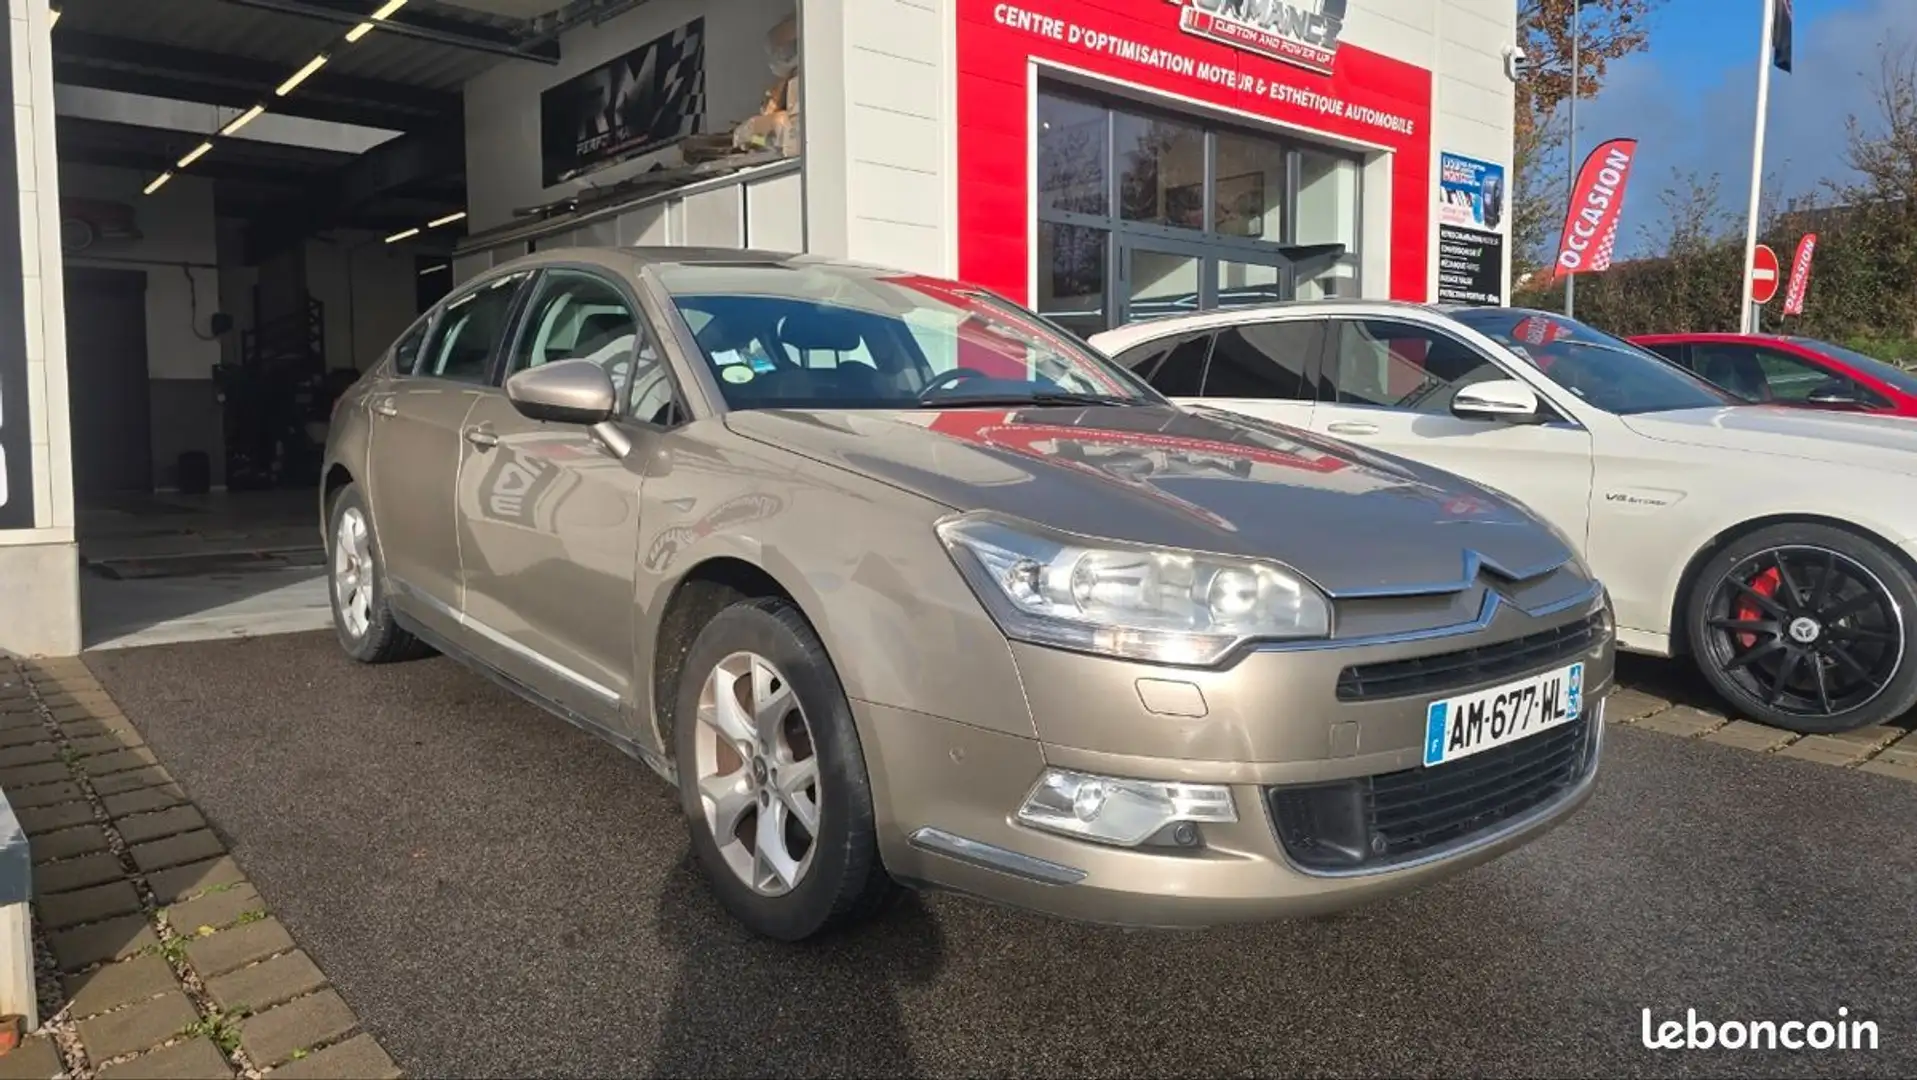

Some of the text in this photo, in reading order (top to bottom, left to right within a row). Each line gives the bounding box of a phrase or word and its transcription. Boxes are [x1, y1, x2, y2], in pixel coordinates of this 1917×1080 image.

[994, 3, 1414, 135] CENTRE D'OPTIMISATION MOTEUR & ESTHÉTIQUE AUTOMOBILE
[1215, 20, 1257, 41] CUSTOM
[1259, 34, 1279, 49] AND
[1281, 42, 1315, 59] POWER
[1560, 148, 1630, 268] OCCASION
[1786, 238, 1814, 309] OCCASION
[1431, 738, 1439, 754] F
[1449, 678, 1565, 752] AM-677-WL
